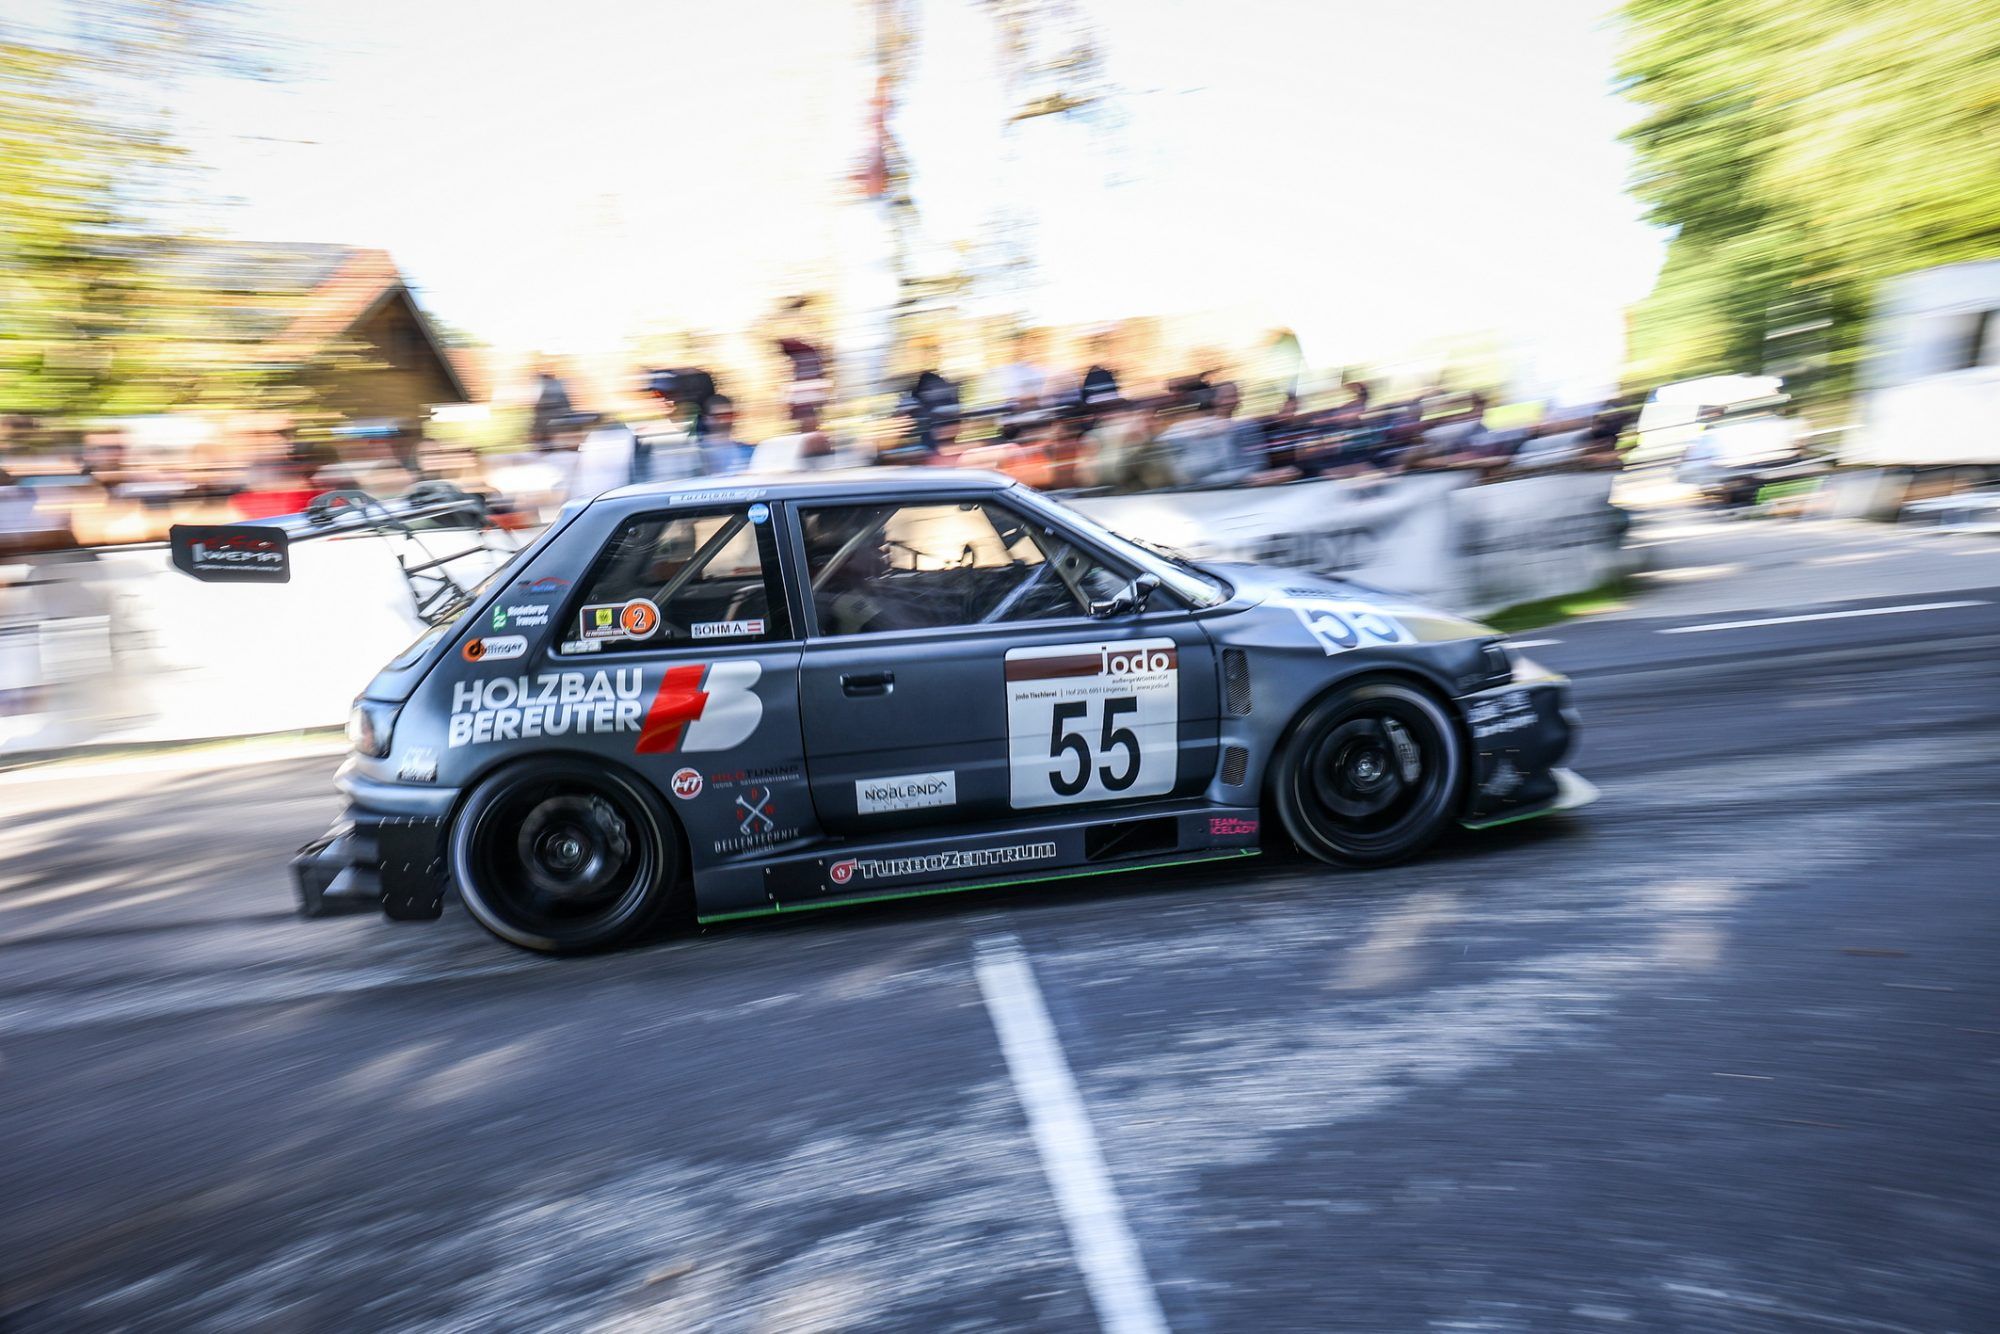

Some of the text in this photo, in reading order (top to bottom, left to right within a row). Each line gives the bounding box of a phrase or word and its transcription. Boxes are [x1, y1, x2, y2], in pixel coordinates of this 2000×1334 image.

[632, 608, 646, 630] 2
[1098, 645, 1170, 677] jodo
[452, 667, 644, 714] HOLZBAU
[448, 700, 642, 749] BEREUTER
[1048, 696, 1142, 797] 55
